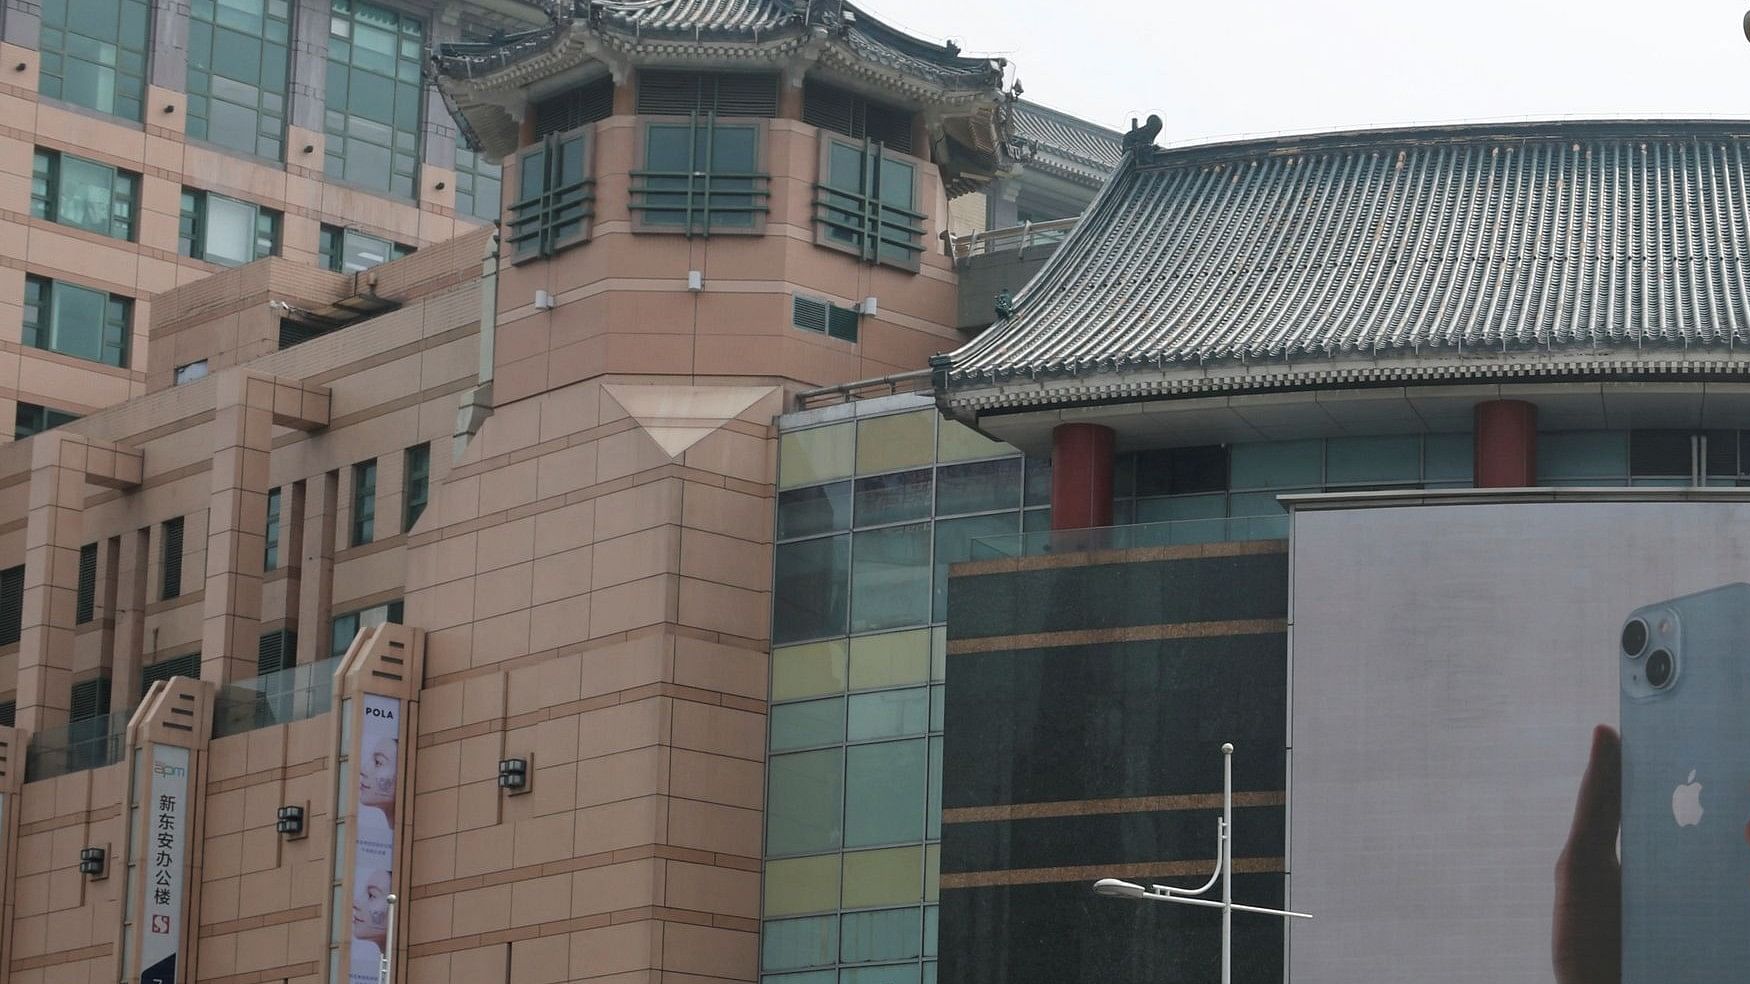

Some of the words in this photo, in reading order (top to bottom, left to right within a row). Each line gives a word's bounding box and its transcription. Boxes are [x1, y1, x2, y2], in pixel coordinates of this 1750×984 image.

[365, 706, 394, 720] POLA
[154, 793, 177, 906] 新东安办公楼
